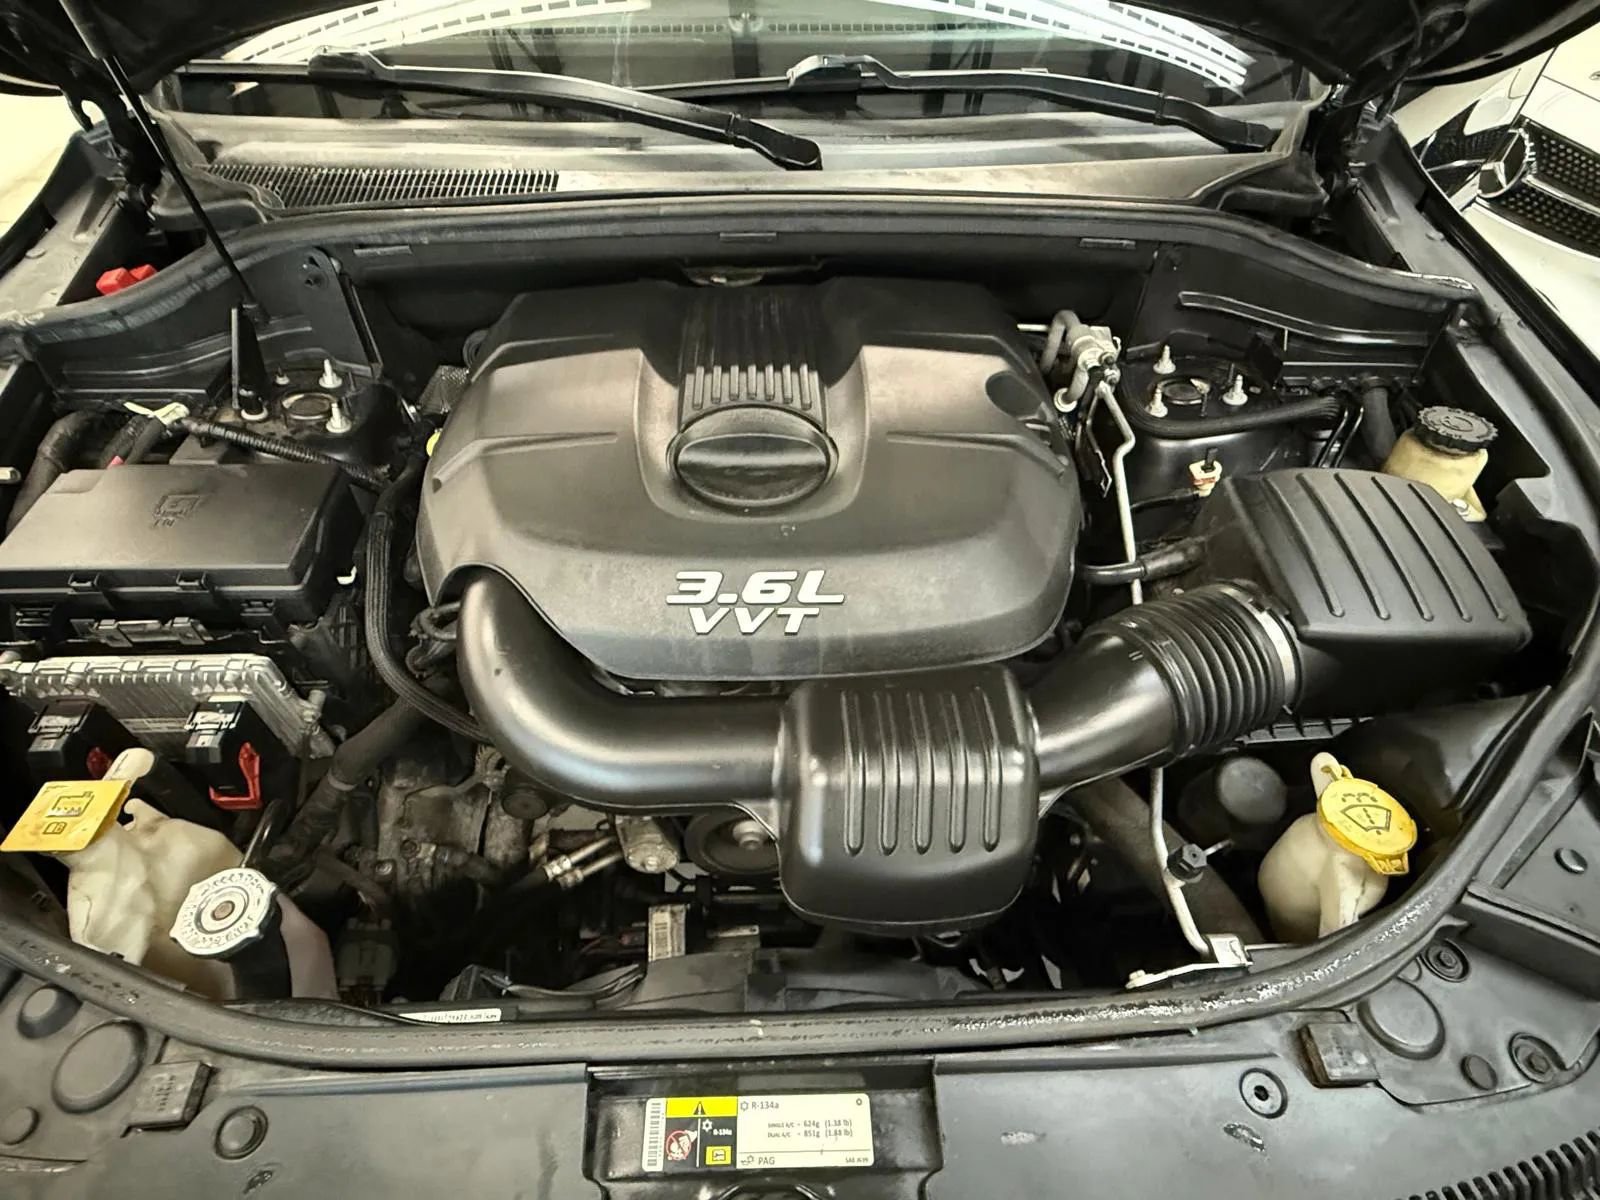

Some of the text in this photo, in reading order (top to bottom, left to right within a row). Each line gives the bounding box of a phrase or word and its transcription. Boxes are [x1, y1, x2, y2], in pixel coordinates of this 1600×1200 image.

[666, 570, 845, 605] 3.6L
[688, 607, 820, 636] VVT
[751, 1101, 780, 1110] R-134a
[803, 1119, 820, 1129] 624g
[842, 1118, 853, 1128] lb)
[803, 1129, 820, 1139] 851g
[843, 1128, 854, 1138] lb)
[757, 1156, 776, 1166] PAG
